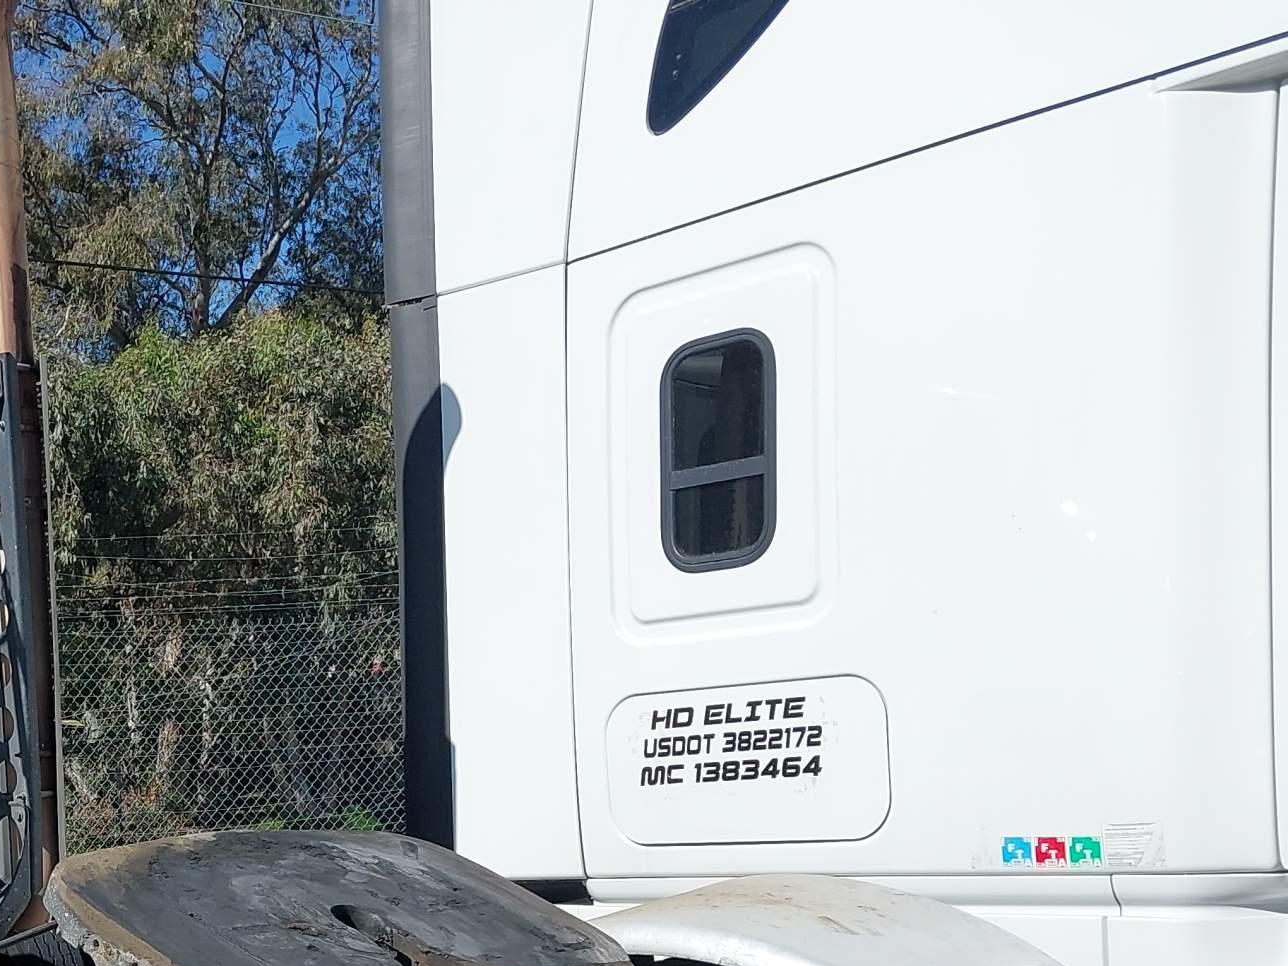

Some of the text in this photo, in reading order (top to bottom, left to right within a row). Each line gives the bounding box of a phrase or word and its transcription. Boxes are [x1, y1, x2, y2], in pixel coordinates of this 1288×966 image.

[650, 696, 806, 730] HD ELITE
[643, 725, 822, 758] USDOT 3822172
[640, 755, 823, 786] MC 1383464
